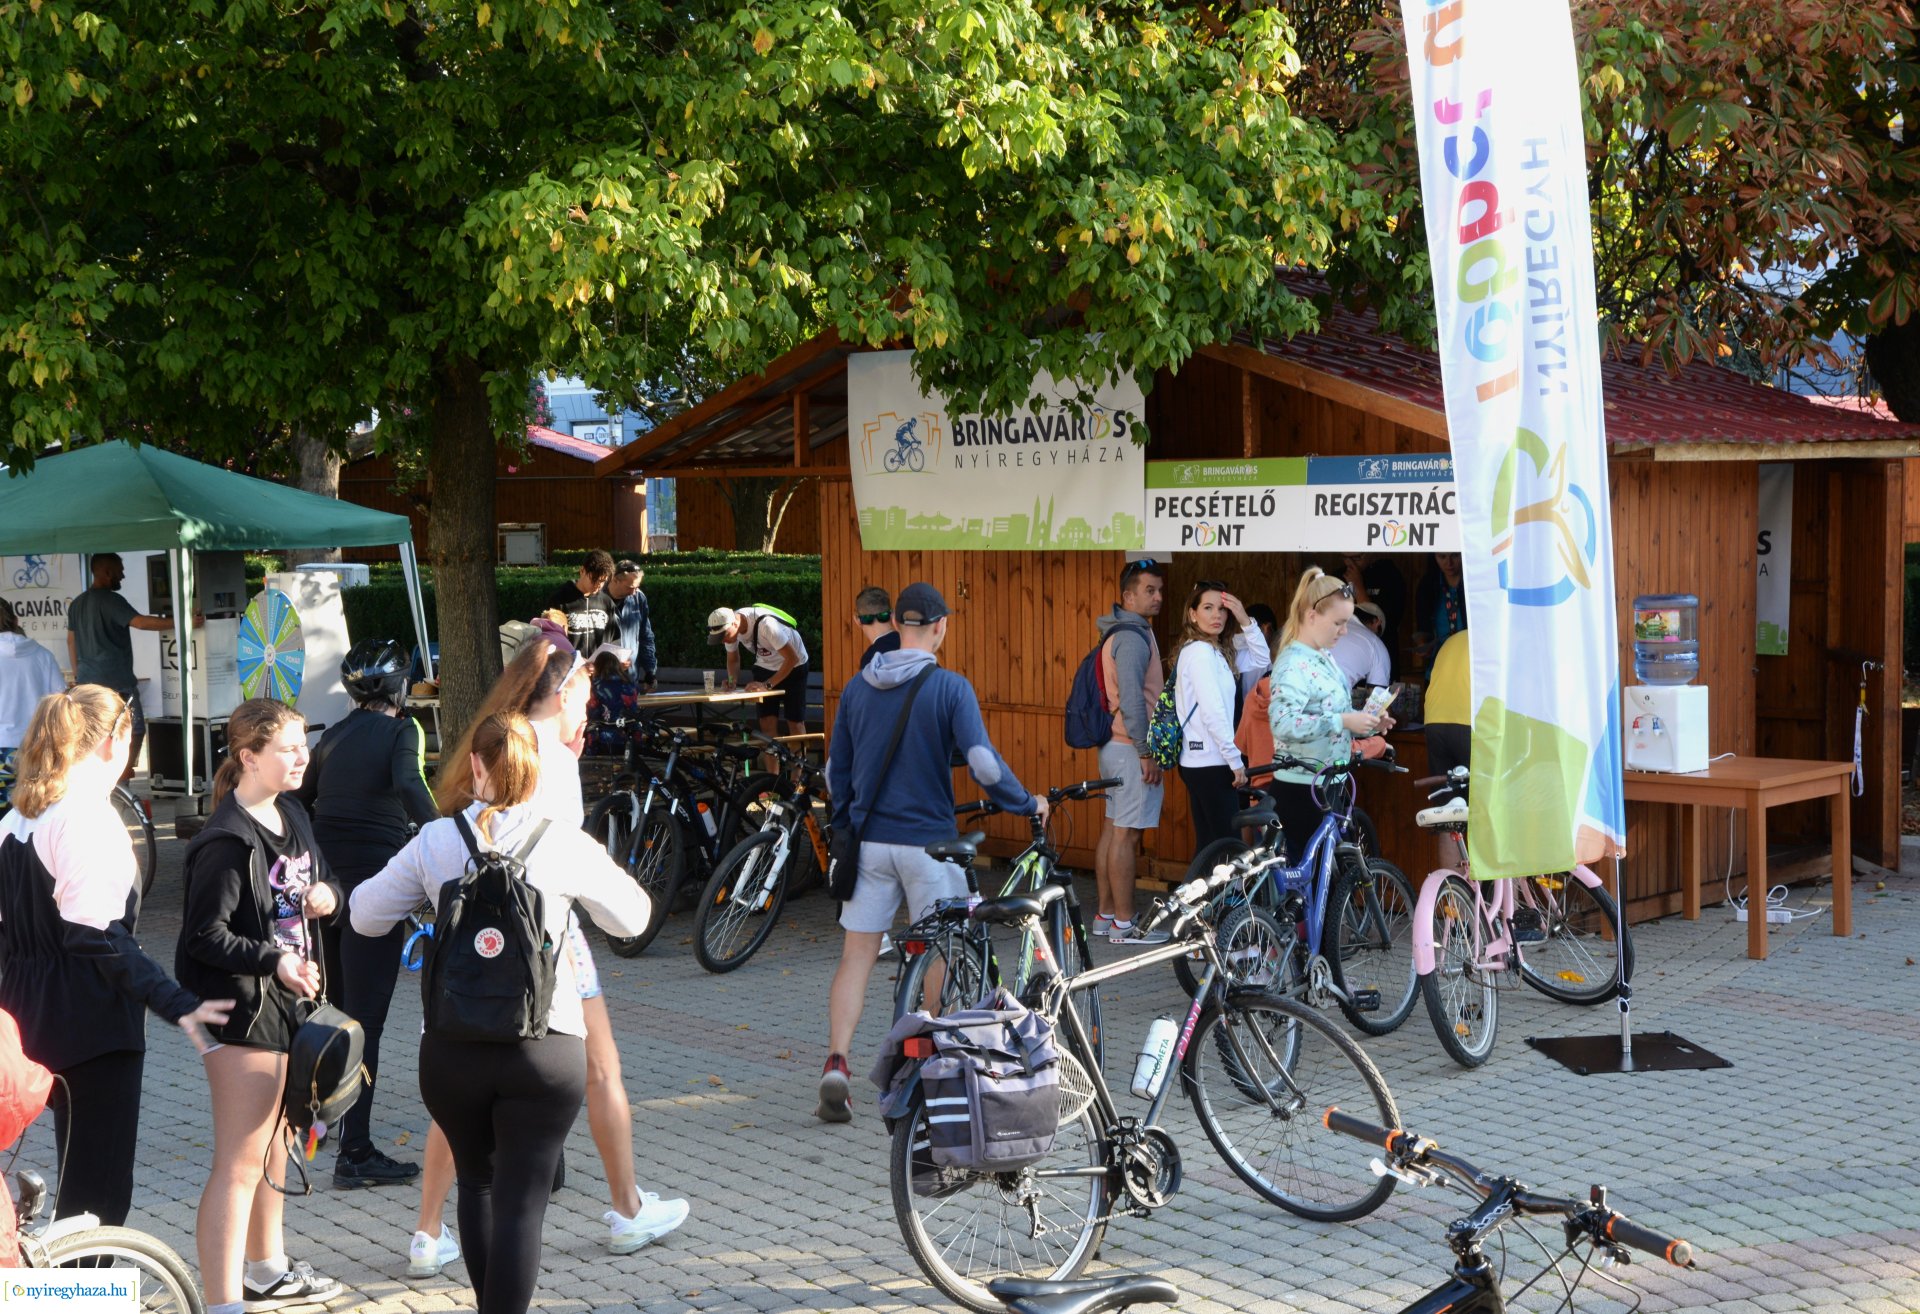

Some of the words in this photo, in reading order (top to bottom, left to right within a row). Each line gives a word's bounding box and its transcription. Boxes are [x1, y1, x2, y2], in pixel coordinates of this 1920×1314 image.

[952, 407, 1126, 447] BRINGAVÁROS
[955, 445, 1123, 469] NYÍREGYHÁZA
[1203, 464, 1258, 476] BRINGAVÁROS
[1155, 489, 1276, 518] PECSÉTELŐ
[1315, 486, 1456, 516] REGISZTRÁC
[1181, 521, 1245, 546] PONT
[1367, 519, 1439, 546] PONT
[1757, 530, 1772, 555] S
[1759, 563, 1769, 576] A
[1151, 1038, 1170, 1077] KOMETA
